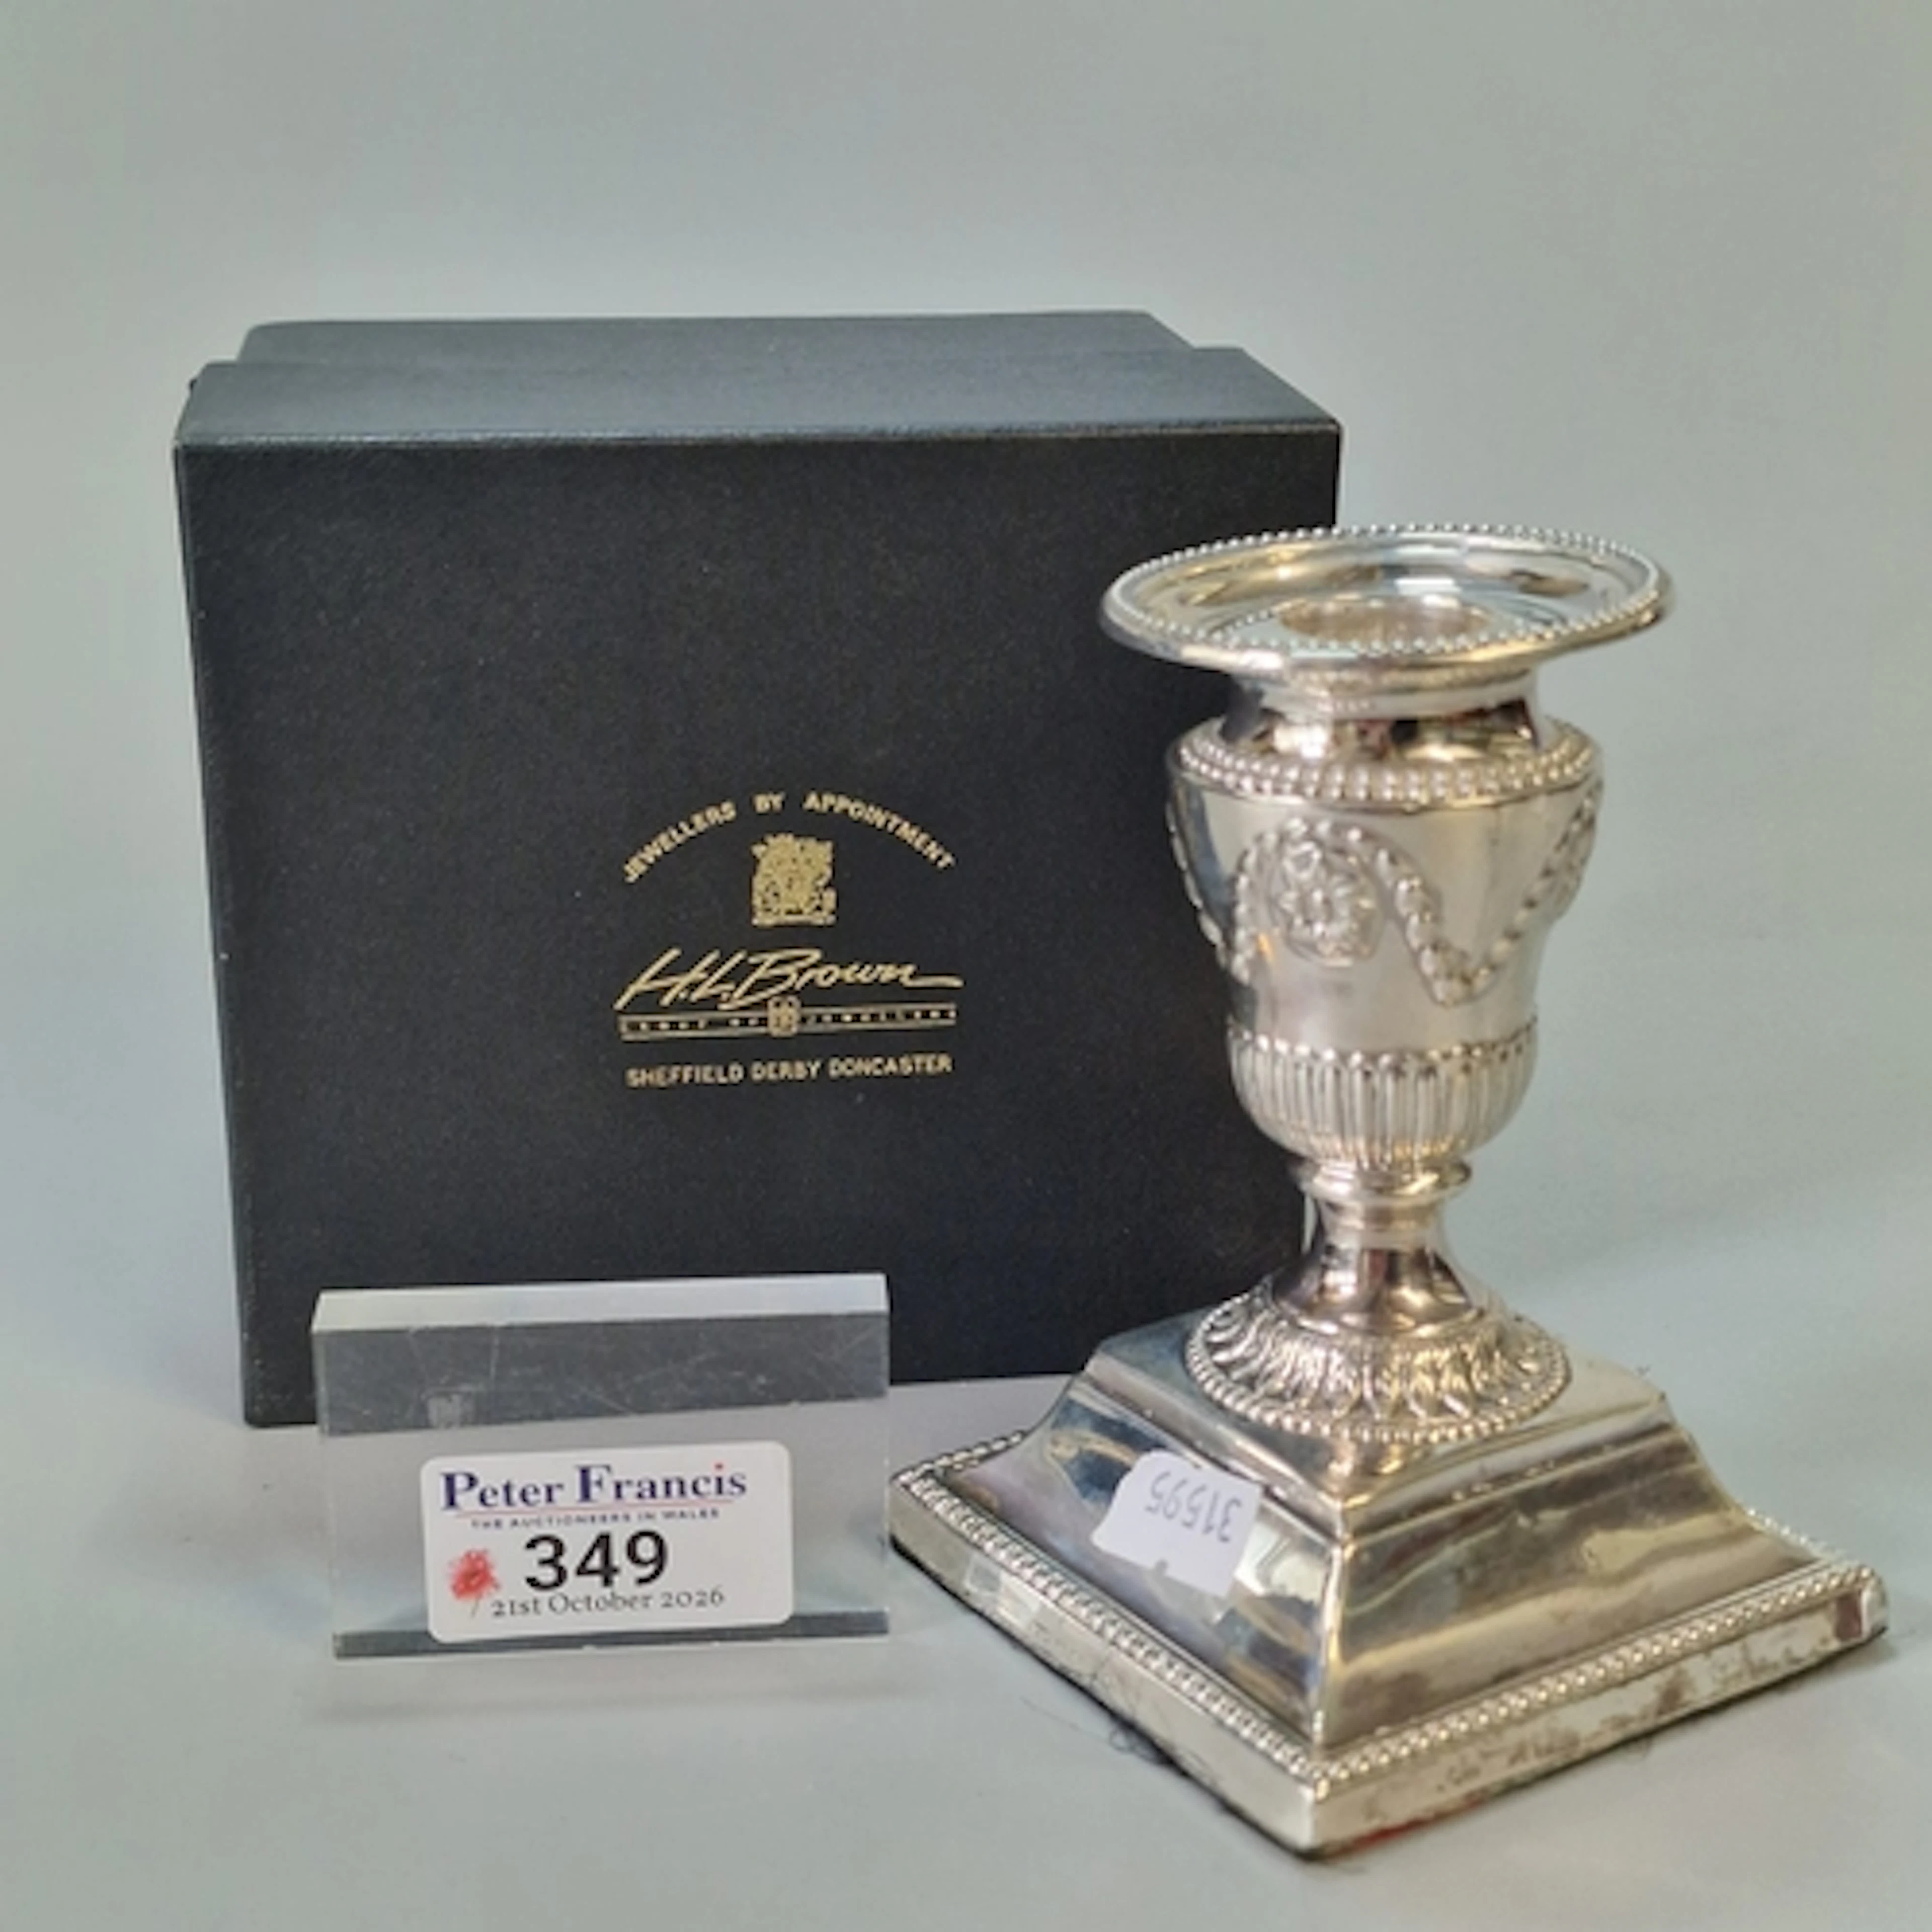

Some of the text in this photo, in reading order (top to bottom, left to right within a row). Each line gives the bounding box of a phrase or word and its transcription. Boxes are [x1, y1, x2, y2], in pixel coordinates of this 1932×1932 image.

[754, 792, 786, 813] BY
[803, 790, 956, 870] APPOINTMENT
[626, 1054, 953, 1089] SHEFFIELD DERBY DONCASTER
[440, 1462, 747, 1509] Peter Francis
[1146, 1471, 1242, 1543] 31595
[471, 1519, 503, 1530] THE
[637, 1511, 656, 1522] IN
[661, 1508, 720, 1520] WALES
[524, 1529, 668, 1592] 349
[490, 1586, 725, 1618] 21st October 2026
